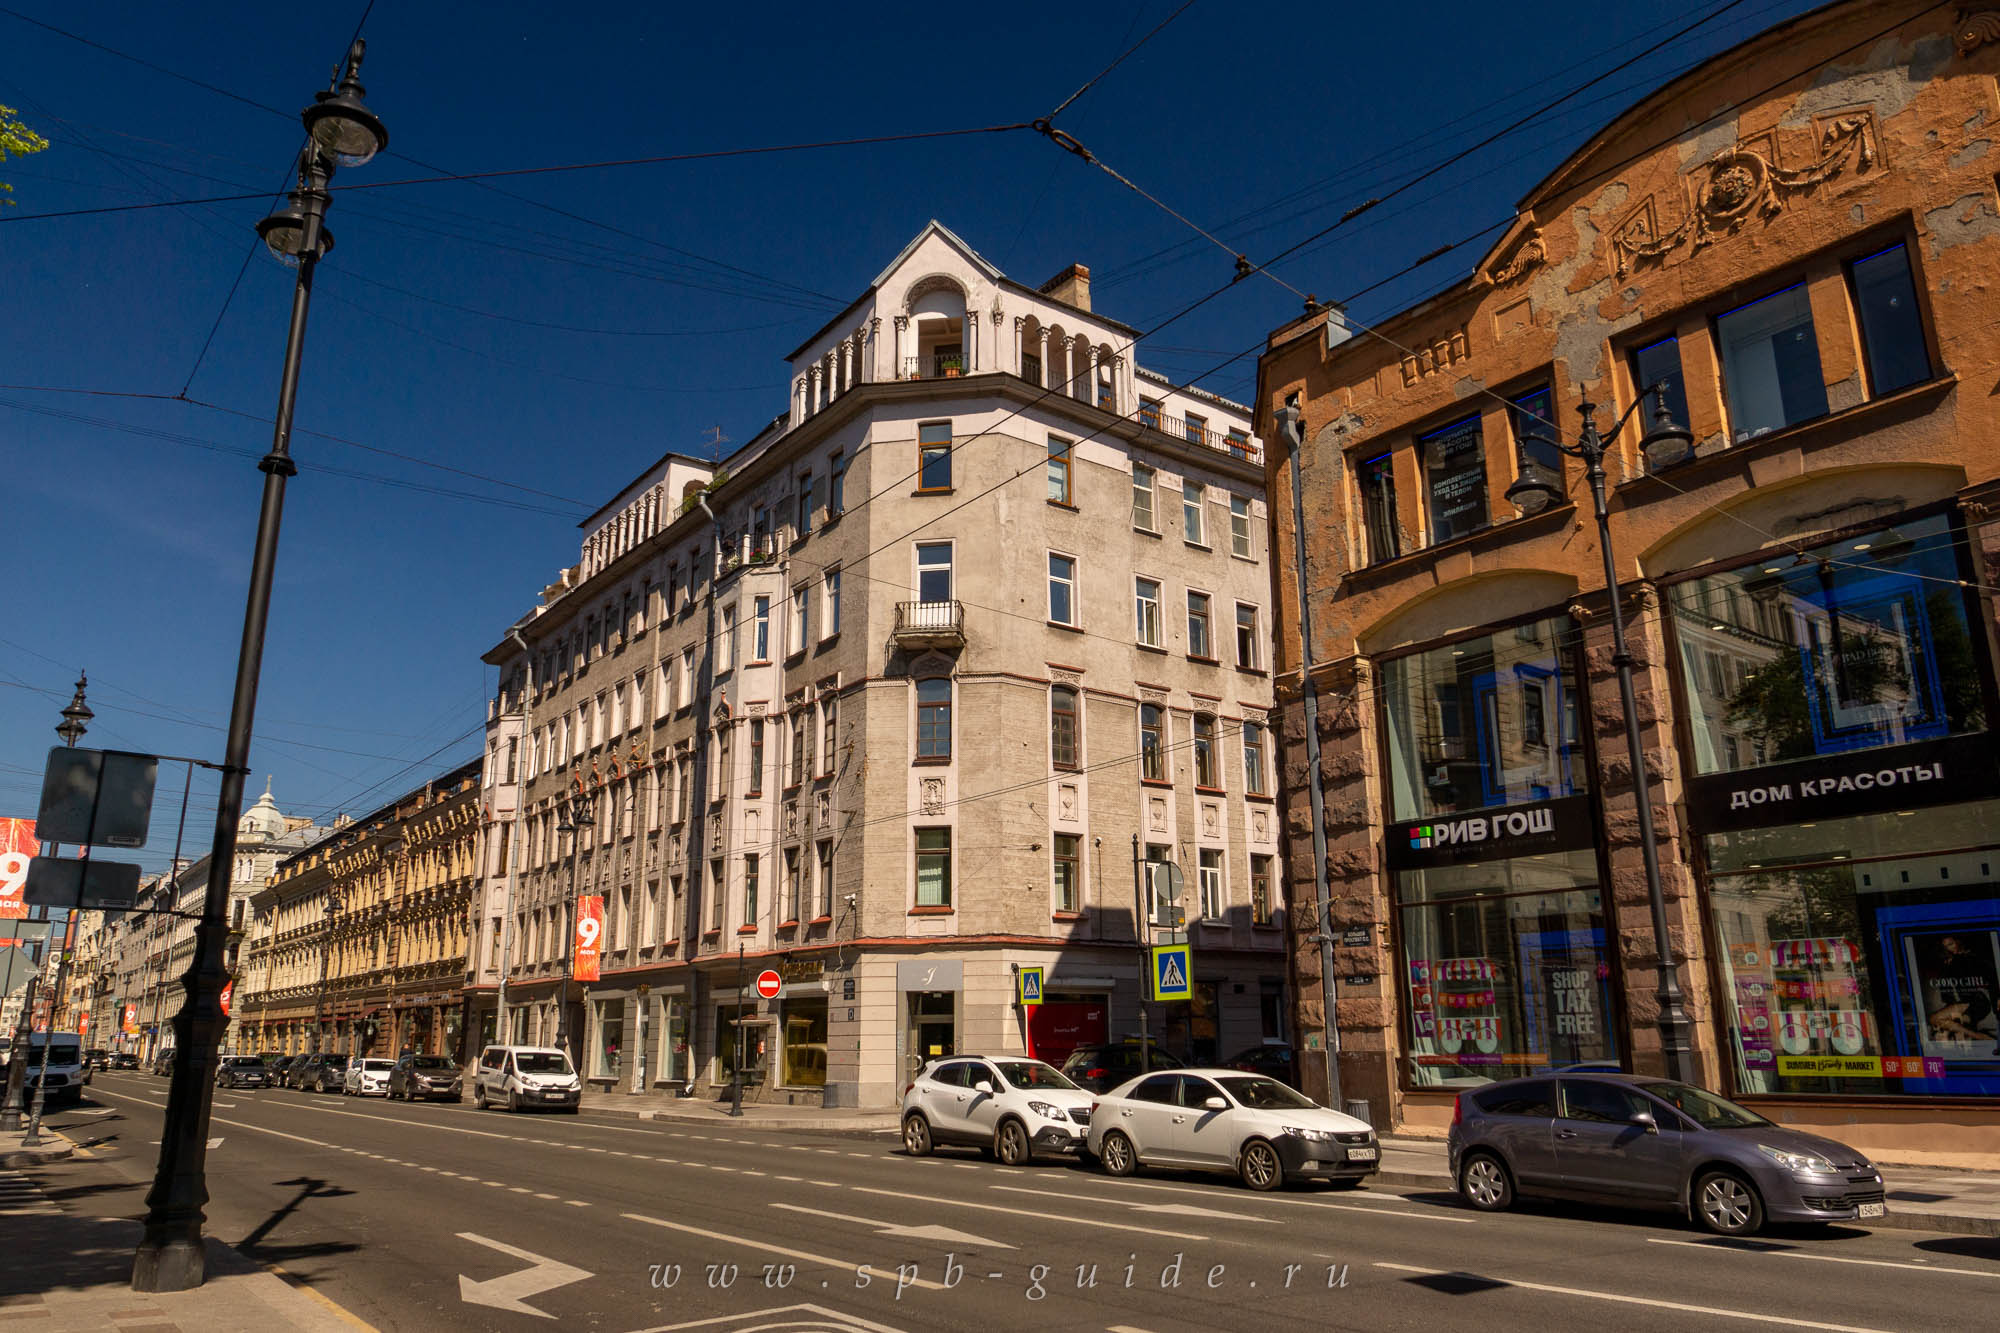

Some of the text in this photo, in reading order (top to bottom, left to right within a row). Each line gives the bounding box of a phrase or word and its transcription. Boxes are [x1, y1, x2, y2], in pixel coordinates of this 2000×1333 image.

[1433, 485, 1450, 497] УХОД
[1450, 482, 1459, 491] ЗА
[1730, 762, 1945, 810] ДОМ КРАСОТЫ
[1433, 818, 1488, 847] РИВ
[1492, 808, 1554, 839] ГОШ
[578, 917, 601, 948] 9
[1552, 970, 1589, 989] SHOP
[1553, 988, 1593, 1014] TAX
[126, 1010, 135, 1021] 9
[1556, 1013, 1595, 1035] FREE
[1845, 1060, 1875, 1071] MARKET
